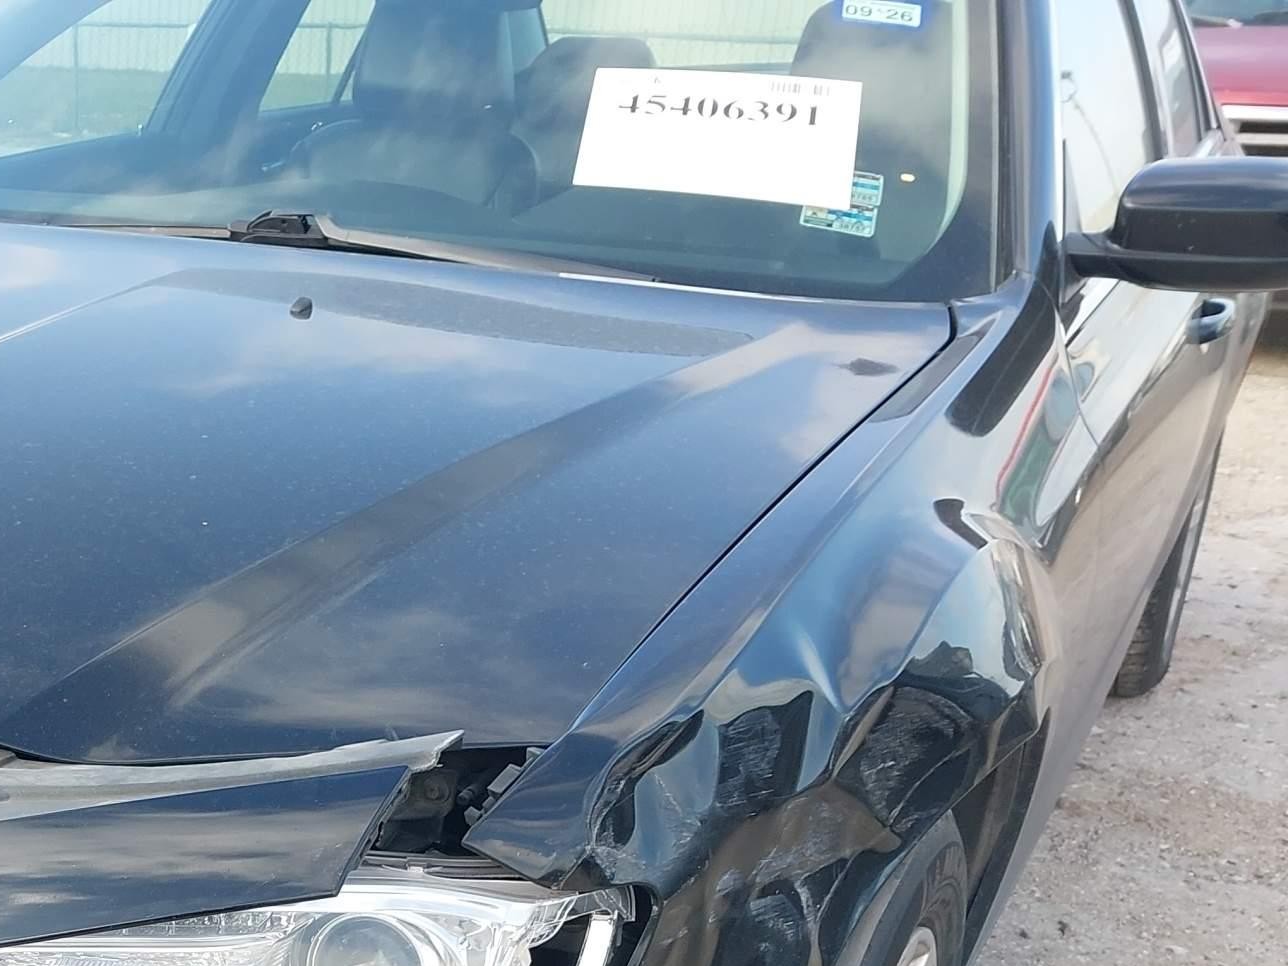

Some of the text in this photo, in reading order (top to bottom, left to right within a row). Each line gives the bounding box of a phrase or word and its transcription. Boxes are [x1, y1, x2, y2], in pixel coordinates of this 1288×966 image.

[845, 4, 913, 22] 09 26
[618, 94, 818, 126] 45406391
